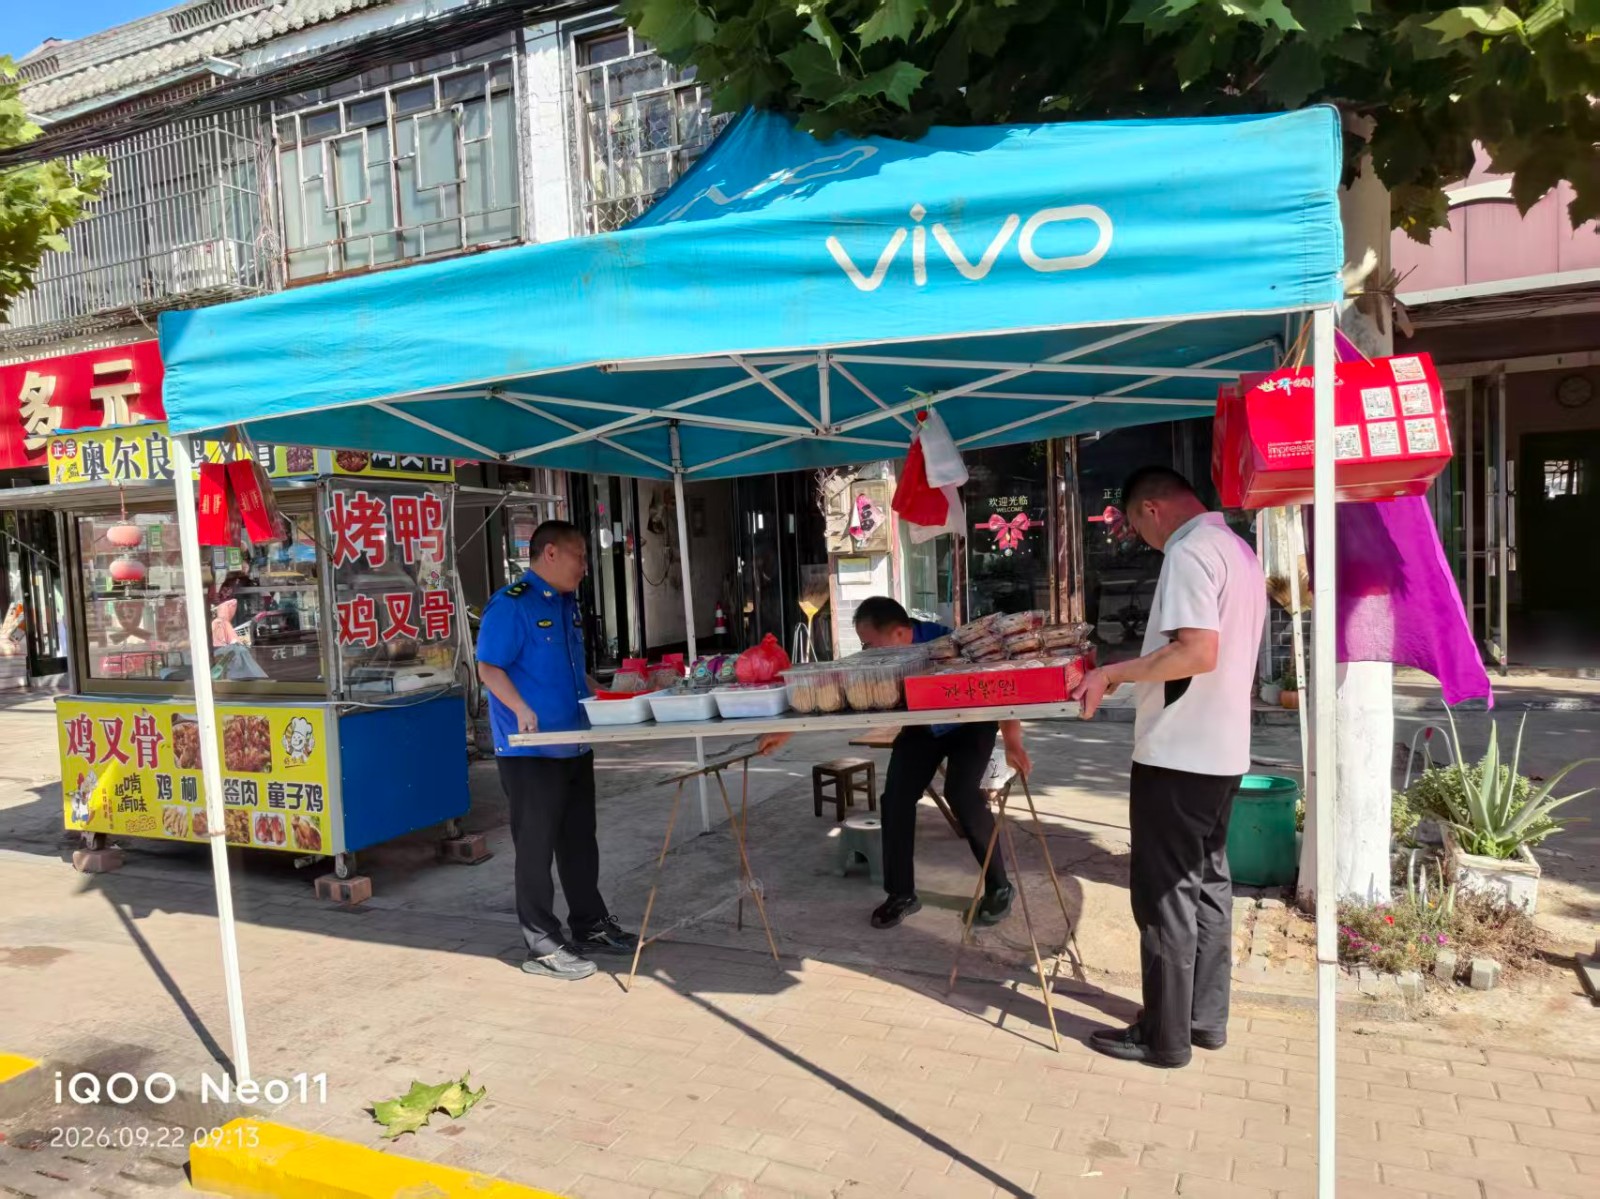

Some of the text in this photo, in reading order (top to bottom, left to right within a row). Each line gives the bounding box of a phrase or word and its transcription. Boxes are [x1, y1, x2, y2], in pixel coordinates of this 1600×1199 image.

[825, 203, 1114, 292] vivo
[325, 491, 446, 569] 烤鸭
[989, 495, 1028, 507] 欢迎光临
[337, 589, 454, 649] 鸡叉骨
[64, 708, 164, 769] 鸡叉骨
[267, 781, 324, 812] 童子鸡
